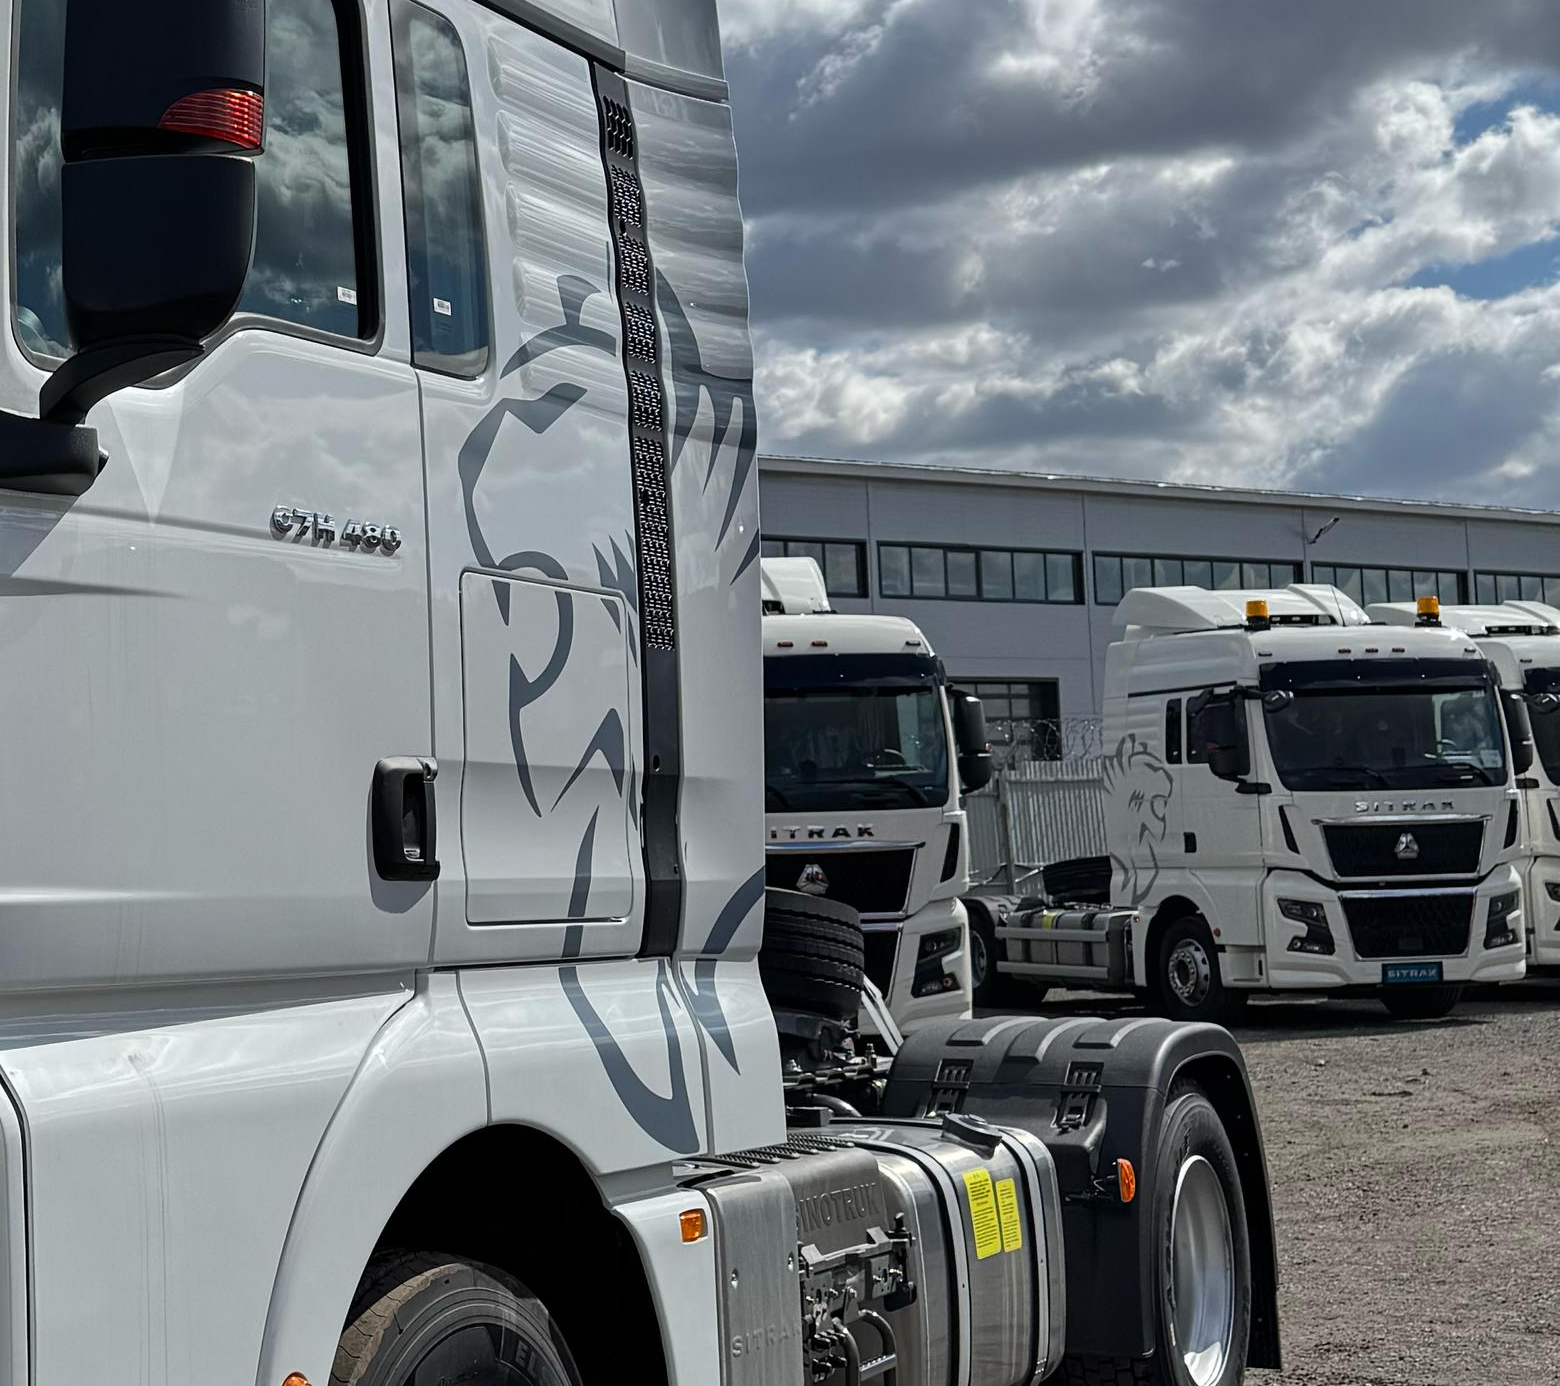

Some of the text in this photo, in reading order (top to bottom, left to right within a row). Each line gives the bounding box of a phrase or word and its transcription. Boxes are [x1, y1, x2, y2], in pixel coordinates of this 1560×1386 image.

[1355, 800, 1454, 812] SITRAK
[768, 823, 875, 839] ITRAK
[799, 1182, 881, 1232] INOTRUK
